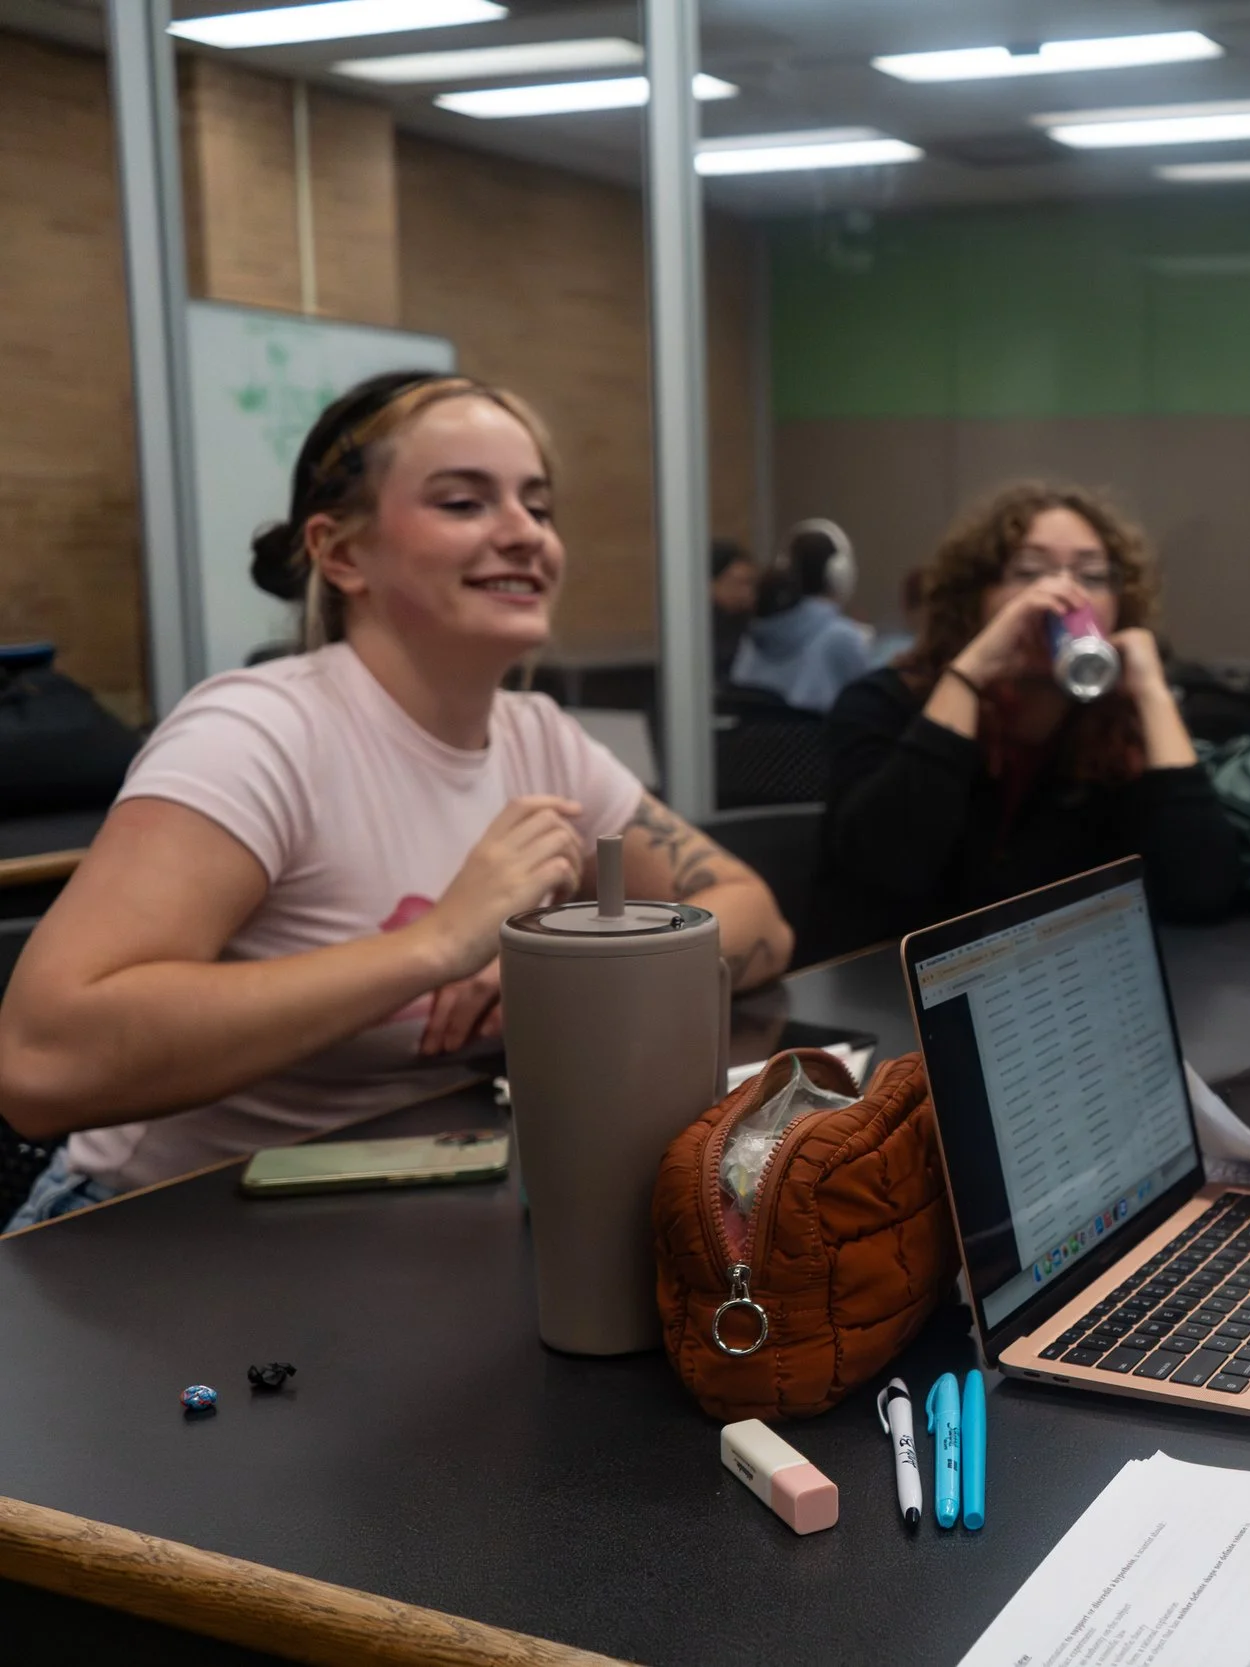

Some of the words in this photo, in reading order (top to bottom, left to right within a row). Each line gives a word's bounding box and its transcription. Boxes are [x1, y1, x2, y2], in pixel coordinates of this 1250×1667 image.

[1177, 1601, 1194, 1620] neither
[1190, 1582, 1207, 1602] definite
[1204, 1569, 1218, 1584] shape
[1214, 1560, 1224, 1570] nor
[1220, 1542, 1236, 1561] definite
[1233, 1526, 1248, 1544] volume
[1065, 1635, 1073, 1643] to
[1070, 1614, 1090, 1636] support
[1092, 1586, 1113, 1609] discredit
